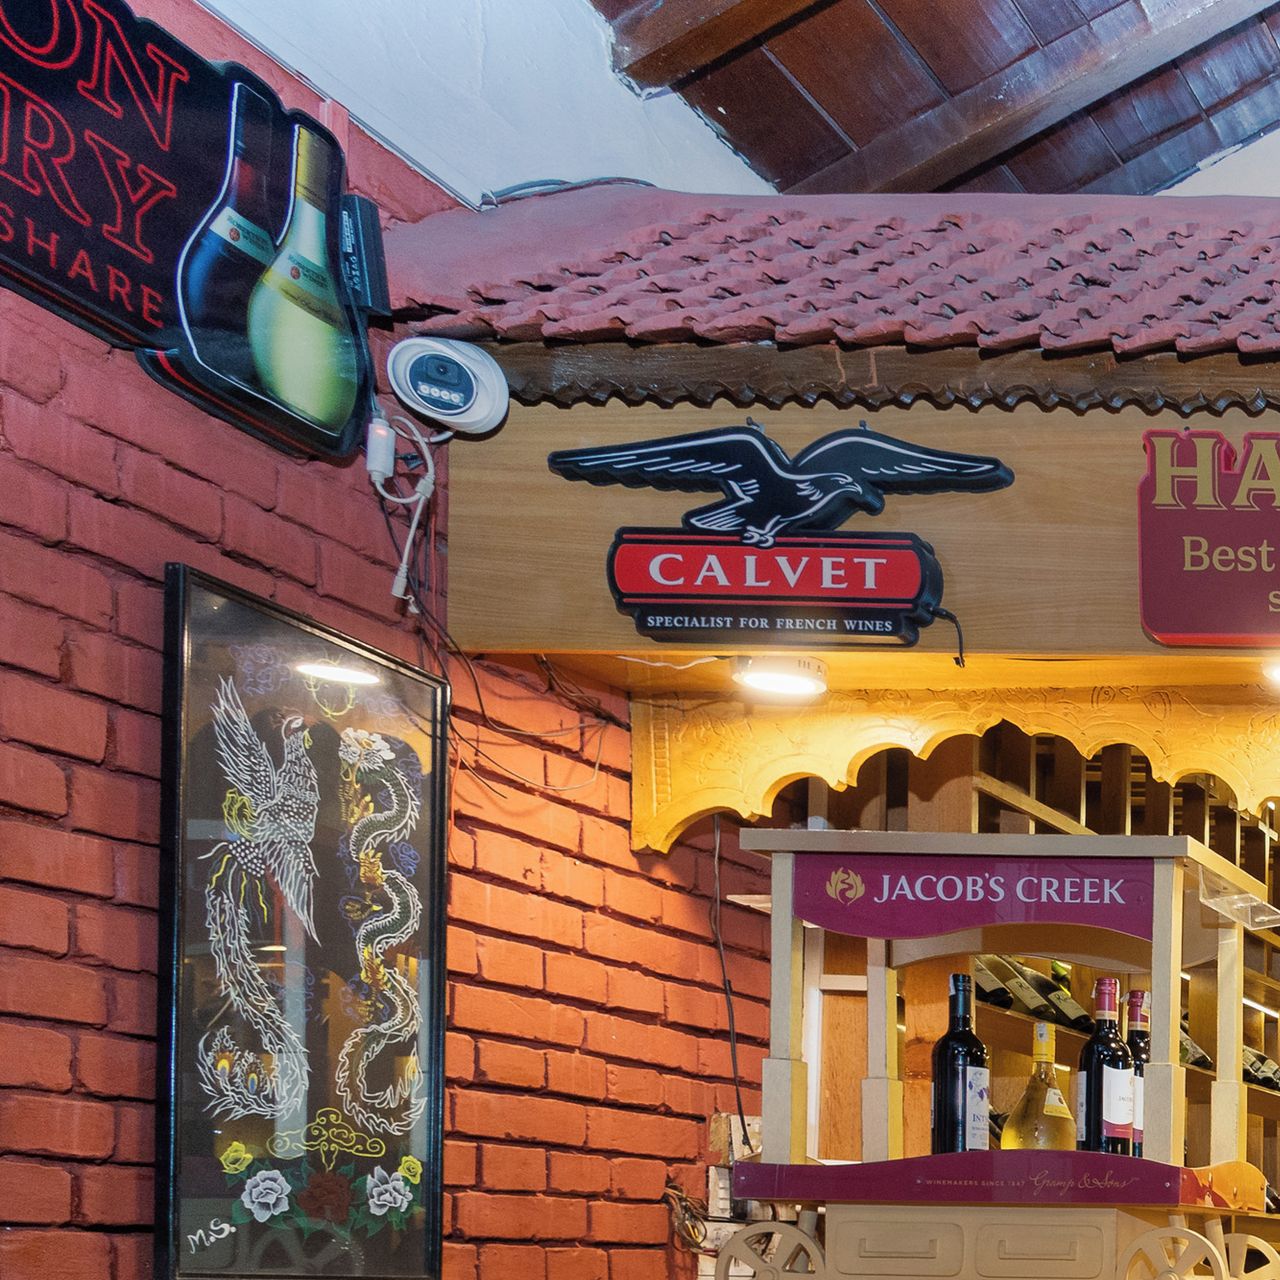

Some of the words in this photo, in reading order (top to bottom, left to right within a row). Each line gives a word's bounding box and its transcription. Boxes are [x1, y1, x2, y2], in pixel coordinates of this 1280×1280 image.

[648, 553, 888, 590] CALVET
[1181, 535, 1276, 573] Best
[647, 615, 734, 629] SPECIALIST
[739, 617, 770, 629] FOR
[776, 618, 837, 630] FRENCH
[843, 619, 893, 632] WINES
[873, 872, 1006, 904] JACOB'S
[1015, 876, 1126, 905] CREEK
